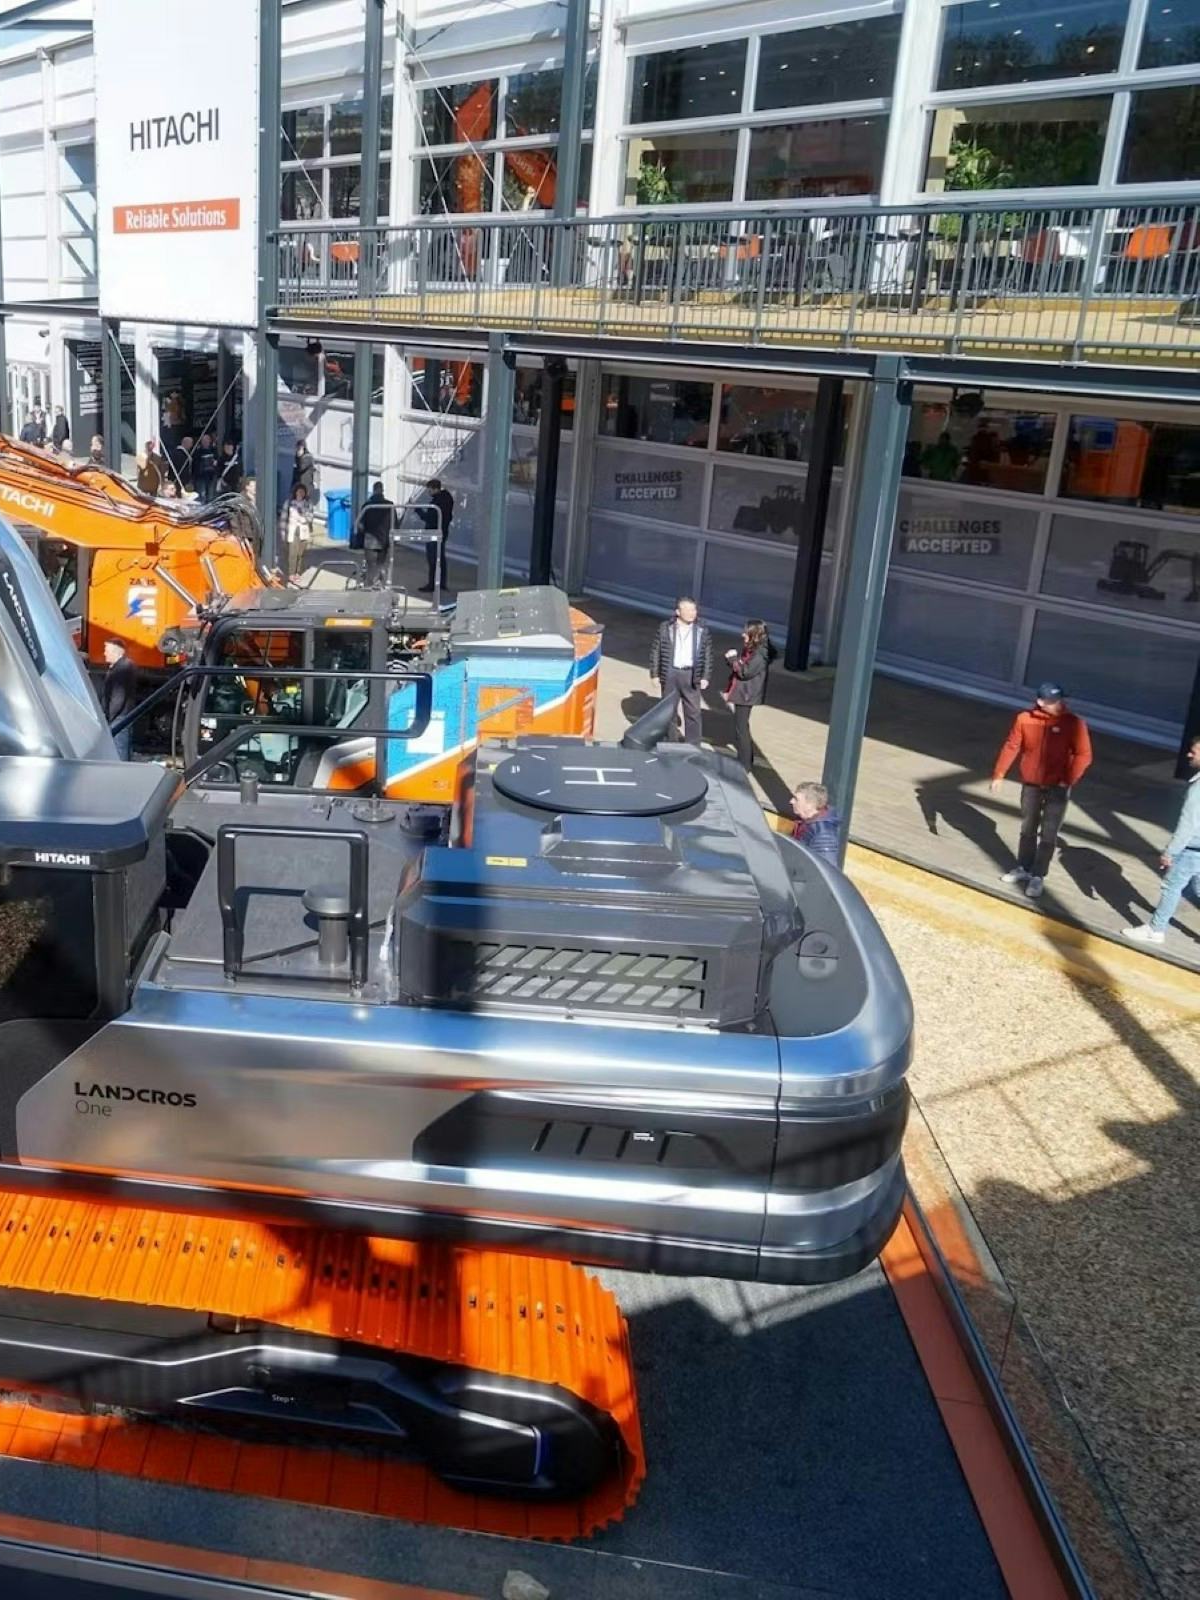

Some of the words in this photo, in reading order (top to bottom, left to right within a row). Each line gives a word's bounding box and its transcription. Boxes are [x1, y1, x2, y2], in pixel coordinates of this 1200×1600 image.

[130, 108, 219, 152] HITACHI
[125, 209, 169, 229] Reliable
[171, 205, 227, 227] Solutions
[615, 471, 682, 483] CHALLENGES
[620, 487, 677, 499] ACCEPTED
[900, 519, 1001, 534] CHALLENGES
[907, 538, 992, 554] ACCEPTED
[35, 852, 90, 865] HITACHI
[74, 1082, 197, 1108] LANDCROS
[75, 1099, 112, 1117] One
